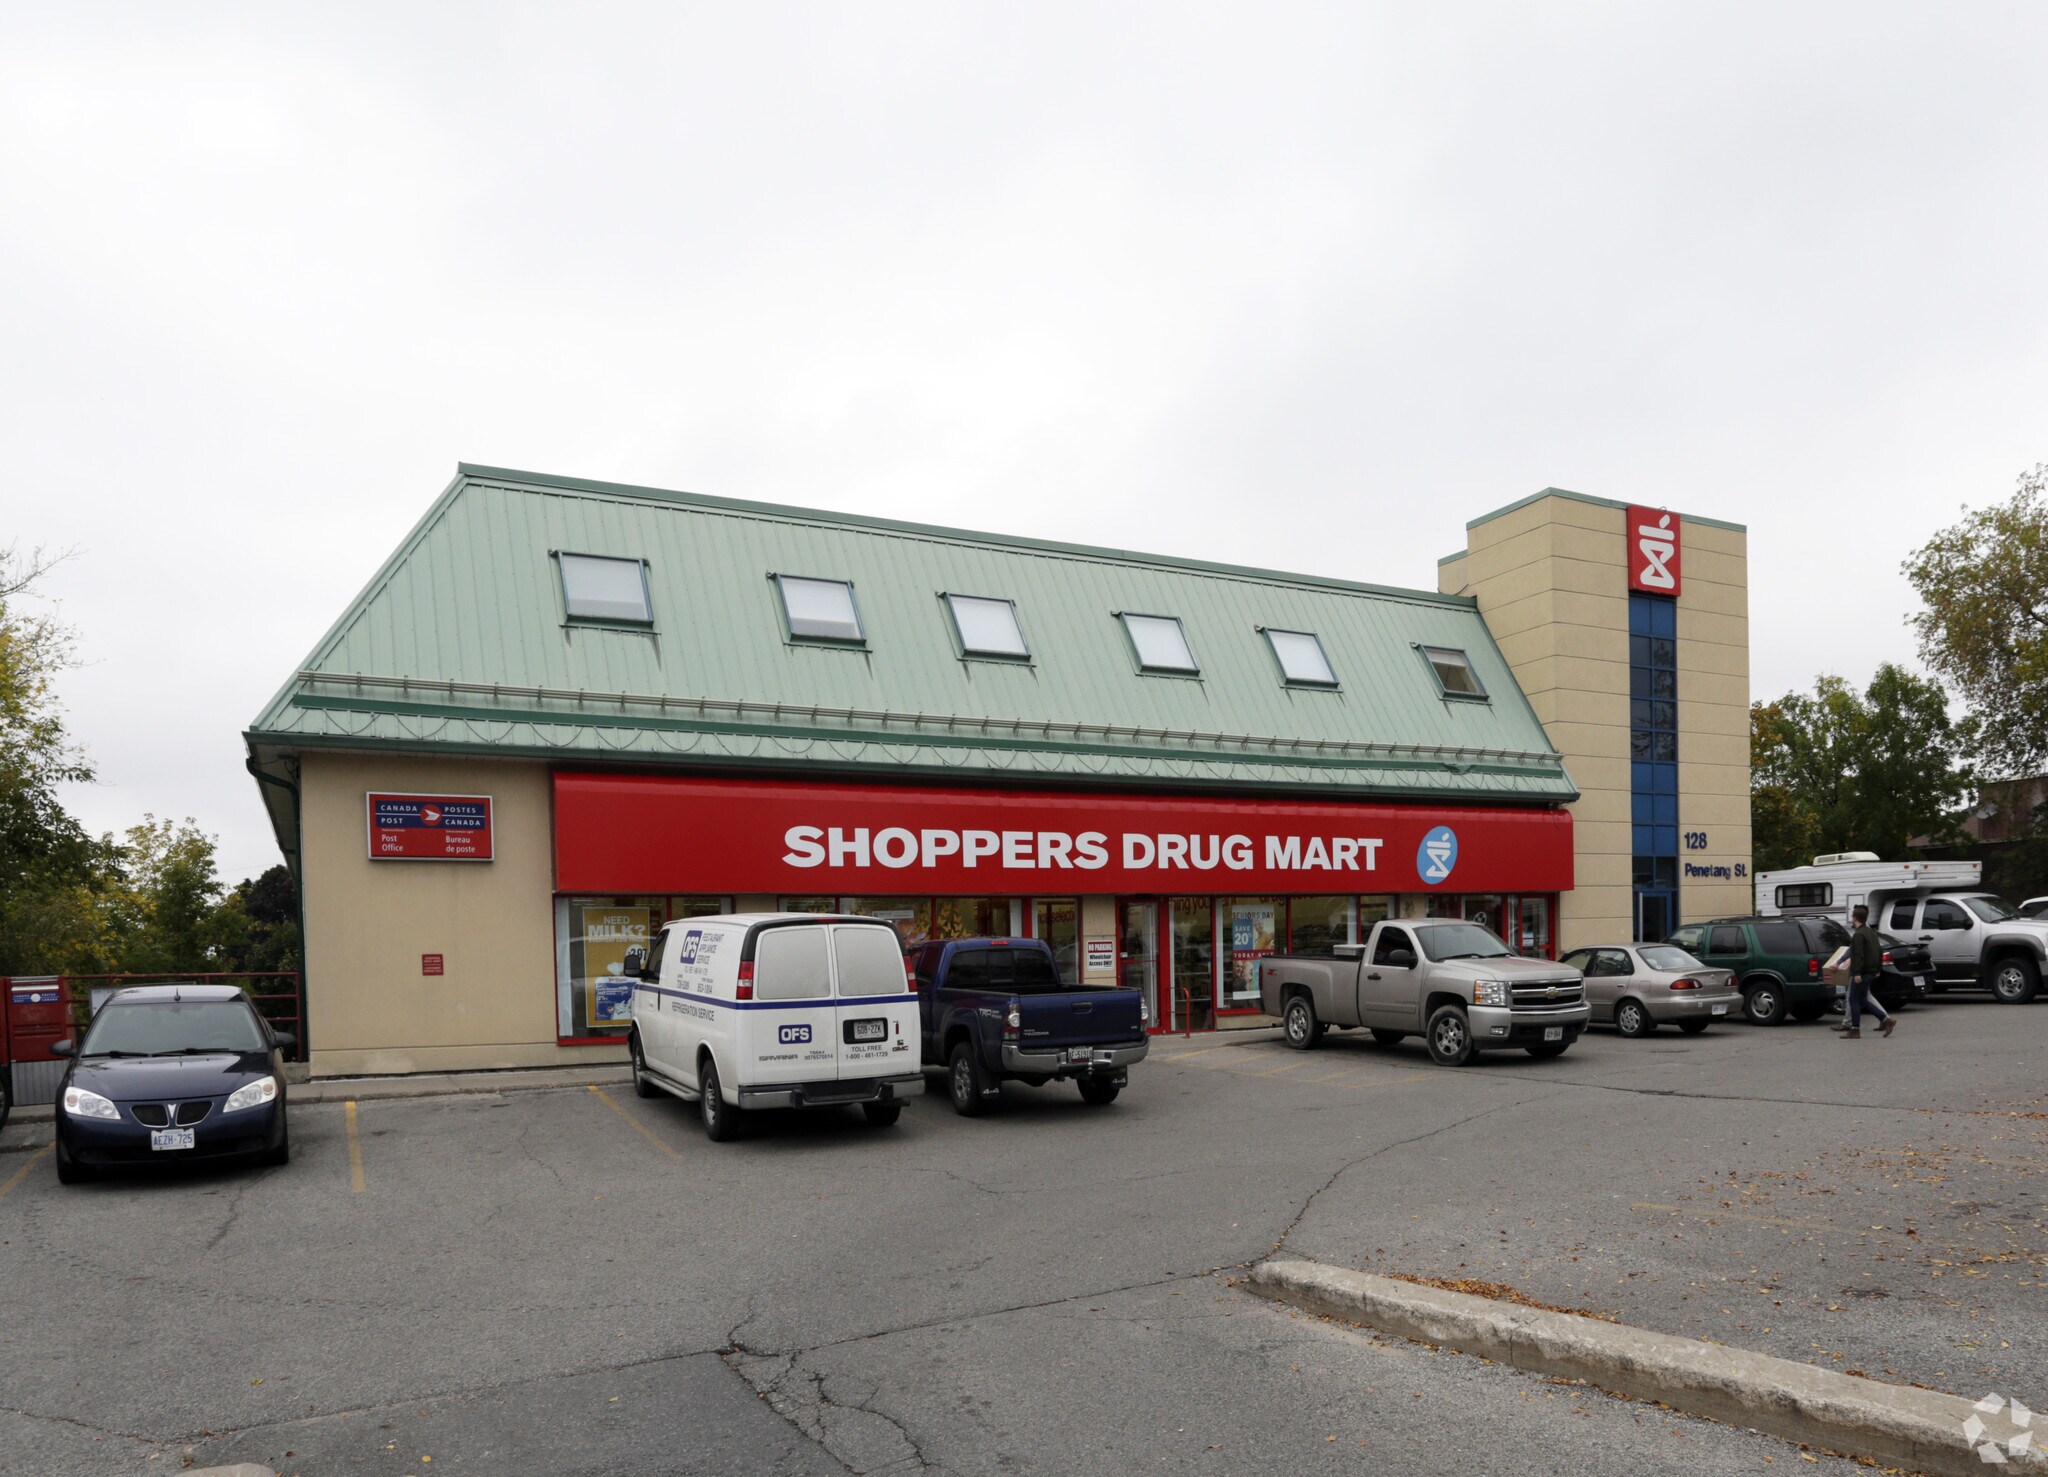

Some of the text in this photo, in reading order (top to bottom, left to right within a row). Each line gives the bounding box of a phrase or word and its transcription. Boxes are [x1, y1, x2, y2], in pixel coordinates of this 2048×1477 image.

[380, 804, 418, 812] CANADA
[444, 806, 476, 814] POSTES
[381, 834, 397, 842] Post
[445, 836, 470, 844] Bureau
[1684, 832, 1707, 849] 128
[381, 844, 404, 852] Office
[446, 845, 476, 854] de poste
[782, 825, 1384, 871] SHOPPERS DRUG MART
[1684, 863, 1731, 879] Penetang
[1261, 911, 1274, 919] DAY
[603, 916, 630, 925] NEED
[588, 925, 646, 937] MILK?
[682, 936, 700, 958] OFS
[1088, 943, 1112, 951] NO PARKING
[698, 1007, 715, 1021] SERVICE
[781, 1027, 810, 1042] OFS
